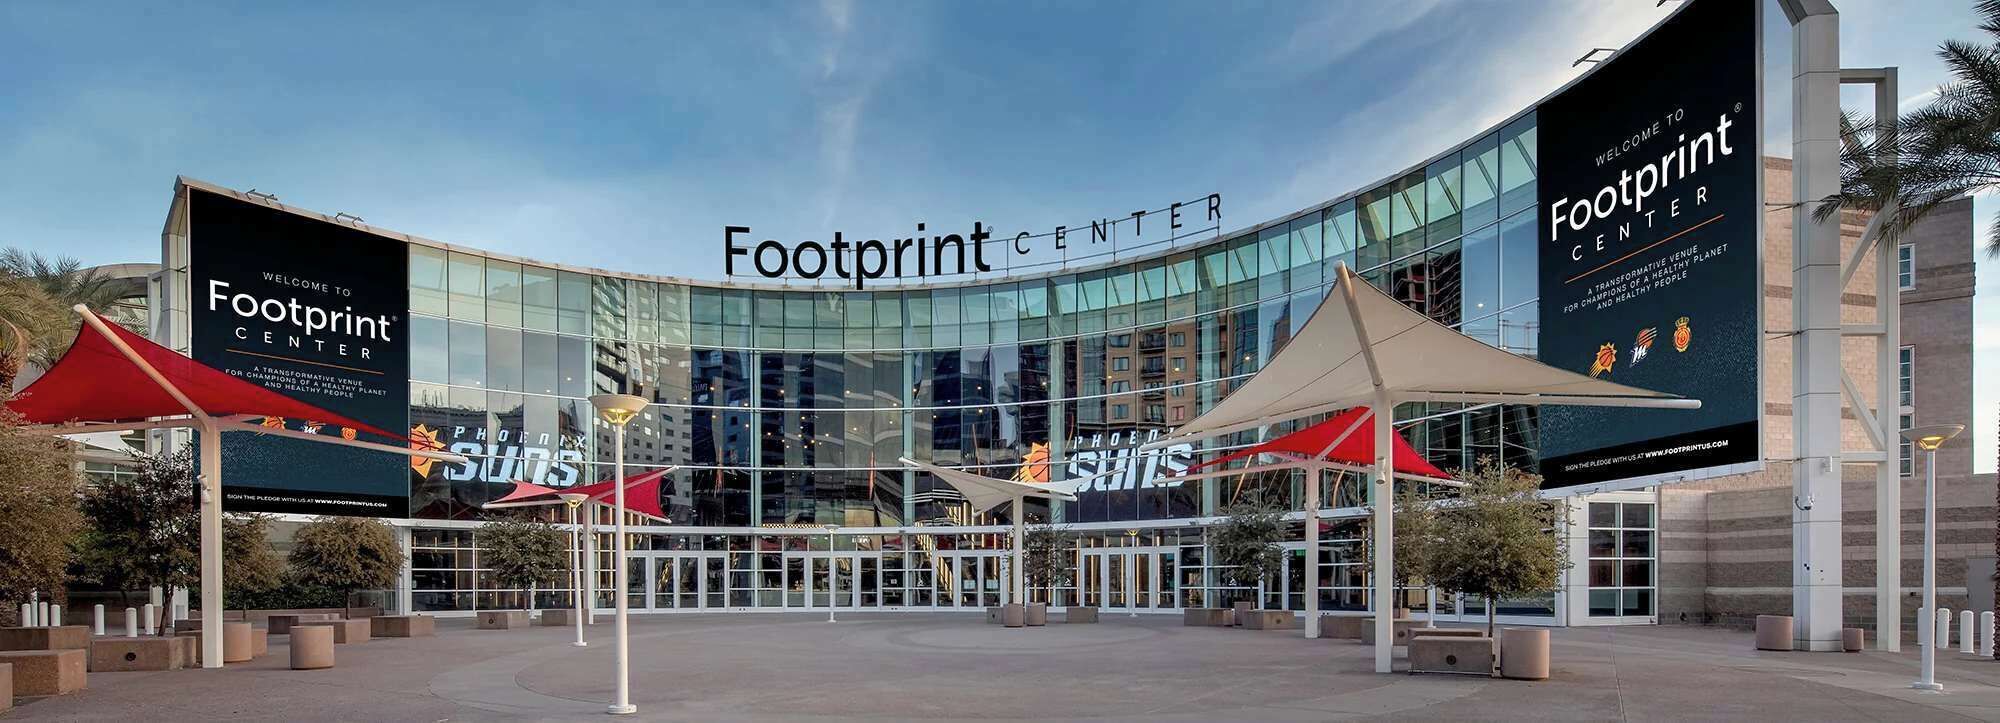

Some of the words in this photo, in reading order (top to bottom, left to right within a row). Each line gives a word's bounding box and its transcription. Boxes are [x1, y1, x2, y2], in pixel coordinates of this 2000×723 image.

[1596, 122, 1660, 167] WELCOME
[1667, 108, 1684, 126] TO
[1015, 193, 1222, 255] CENTER
[1572, 187, 1707, 261] CENTER
[263, 271, 329, 293] WELCOME
[335, 286, 351, 297] TO
[1563, 302, 1579, 314] FOR
[1581, 284, 1627, 308] CHAMPIONS
[1630, 278, 1640, 289] OF
[1652, 259, 1690, 280] HEALTHY
[1693, 243, 1728, 263] PLANET
[1595, 257, 1666, 292] TRANSFORMATIVE
[1669, 244, 1698, 263] VENUE
[1597, 299, 1613, 311] AND
[1616, 284, 1651, 303] HEALTHY
[1654, 270, 1687, 289] PEOPLE
[235, 327, 371, 359] CENTER
[225, 368, 243, 377] FOR
[246, 371, 297, 384] CHAMPIONS
[322, 382, 356, 391] HEALTHY
[359, 387, 387, 396] PLANET
[263, 367, 335, 383] TRANSFORMATIVE
[338, 378, 363, 387] VENUE
[285, 384, 321, 393] HEALTHY
[324, 388, 354, 398] PEOPLE
[454, 425, 586, 449] PHOENIX
[443, 441, 585, 487] SUNS
[1565, 463, 1579, 472] SIGN
[1578, 461, 1590, 469] THE
[1590, 458, 1612, 467] PLEDGE
[1612, 456, 1628, 464] WITH
[1645, 440, 1729, 458] WWW.FOOTPRINTUS.COM
